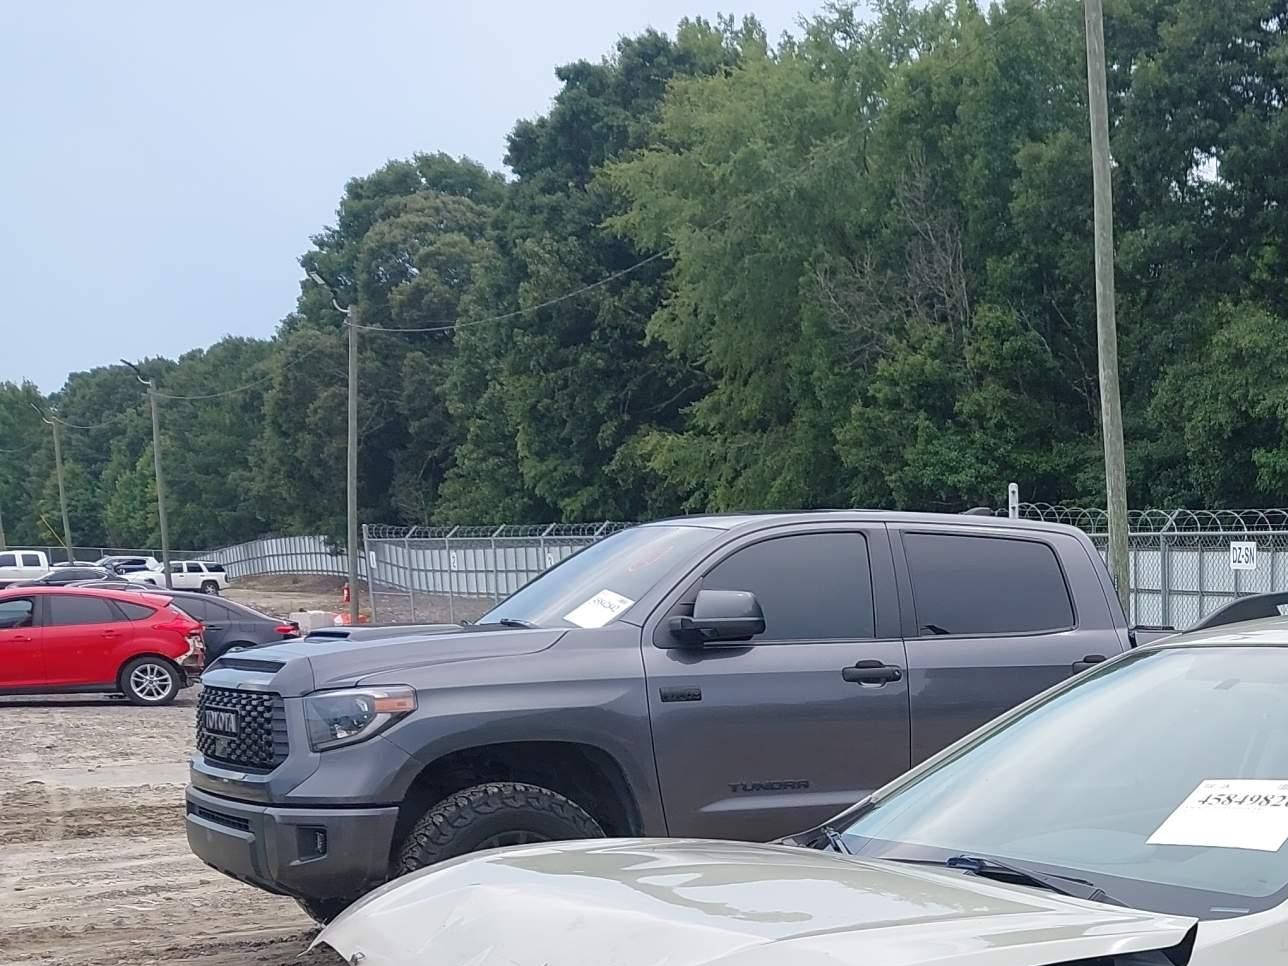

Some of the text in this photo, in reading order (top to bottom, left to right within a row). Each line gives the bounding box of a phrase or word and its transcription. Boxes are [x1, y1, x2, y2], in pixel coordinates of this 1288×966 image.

[1232, 546, 1255, 564] DZ-SN
[207, 710, 236, 733] TOYOTA
[728, 779, 810, 793] TUNDRA
